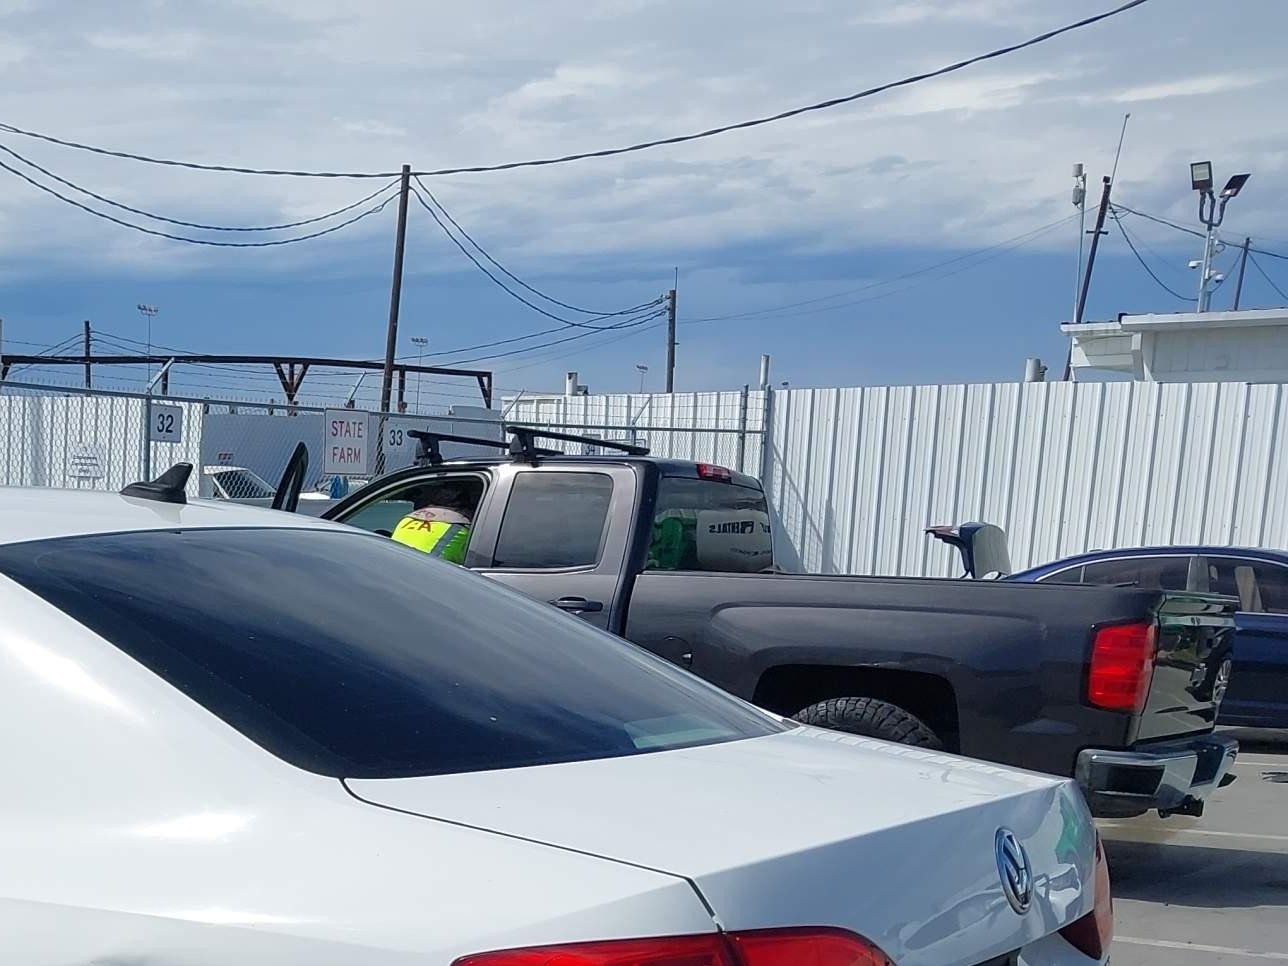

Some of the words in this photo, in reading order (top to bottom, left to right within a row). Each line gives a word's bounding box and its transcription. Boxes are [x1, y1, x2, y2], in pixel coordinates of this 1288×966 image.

[157, 413, 174, 433] 32
[331, 420, 364, 438] STATE
[389, 429, 403, 446] 33
[331, 446, 361, 463] FARM
